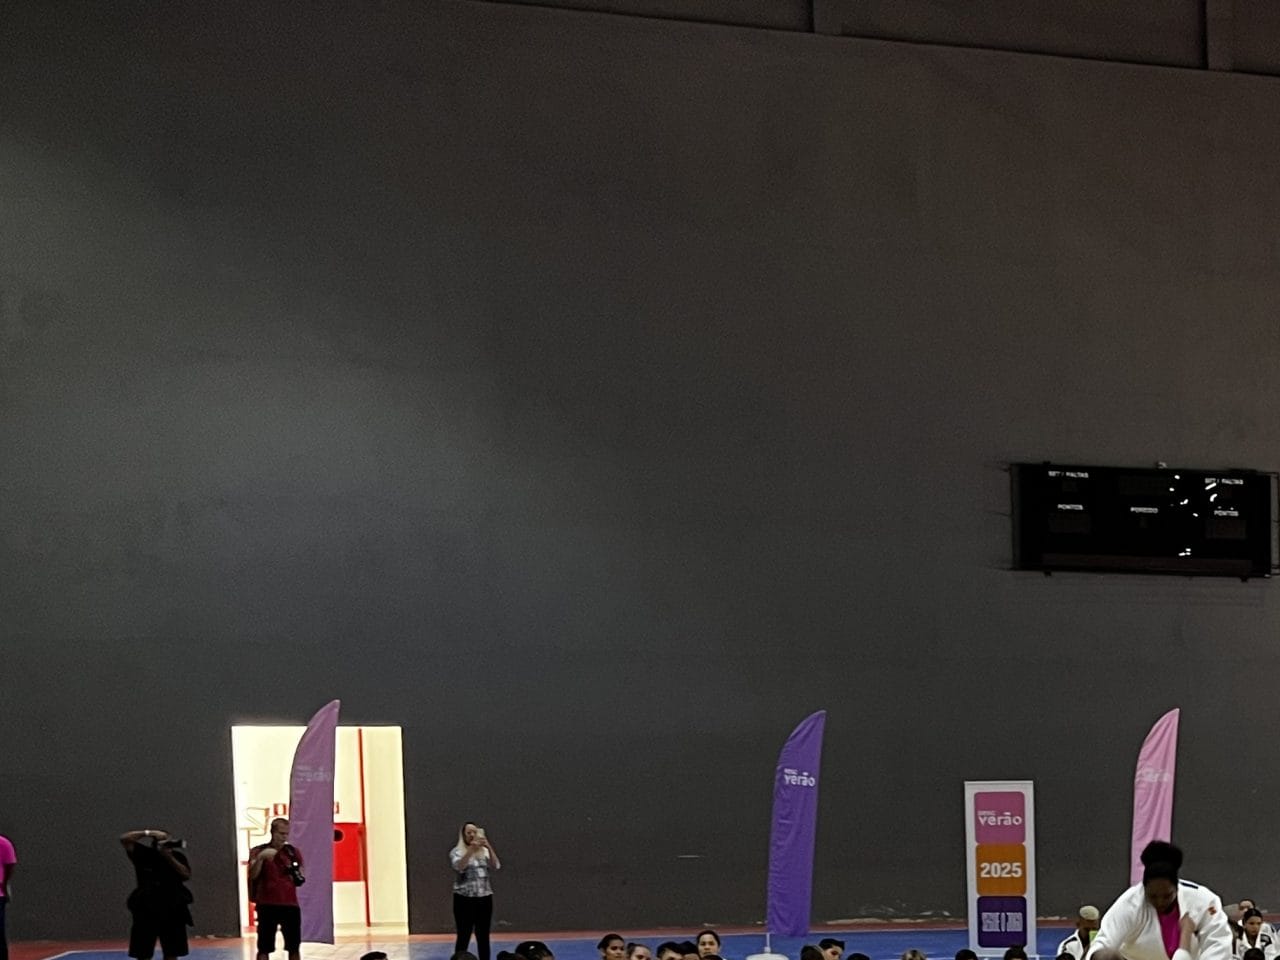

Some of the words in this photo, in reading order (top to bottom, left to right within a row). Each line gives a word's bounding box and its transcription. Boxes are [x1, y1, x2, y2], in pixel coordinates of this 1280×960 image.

[783, 771, 816, 787] verão
[977, 811, 1022, 826] verão
[979, 862, 1023, 878] 2025
